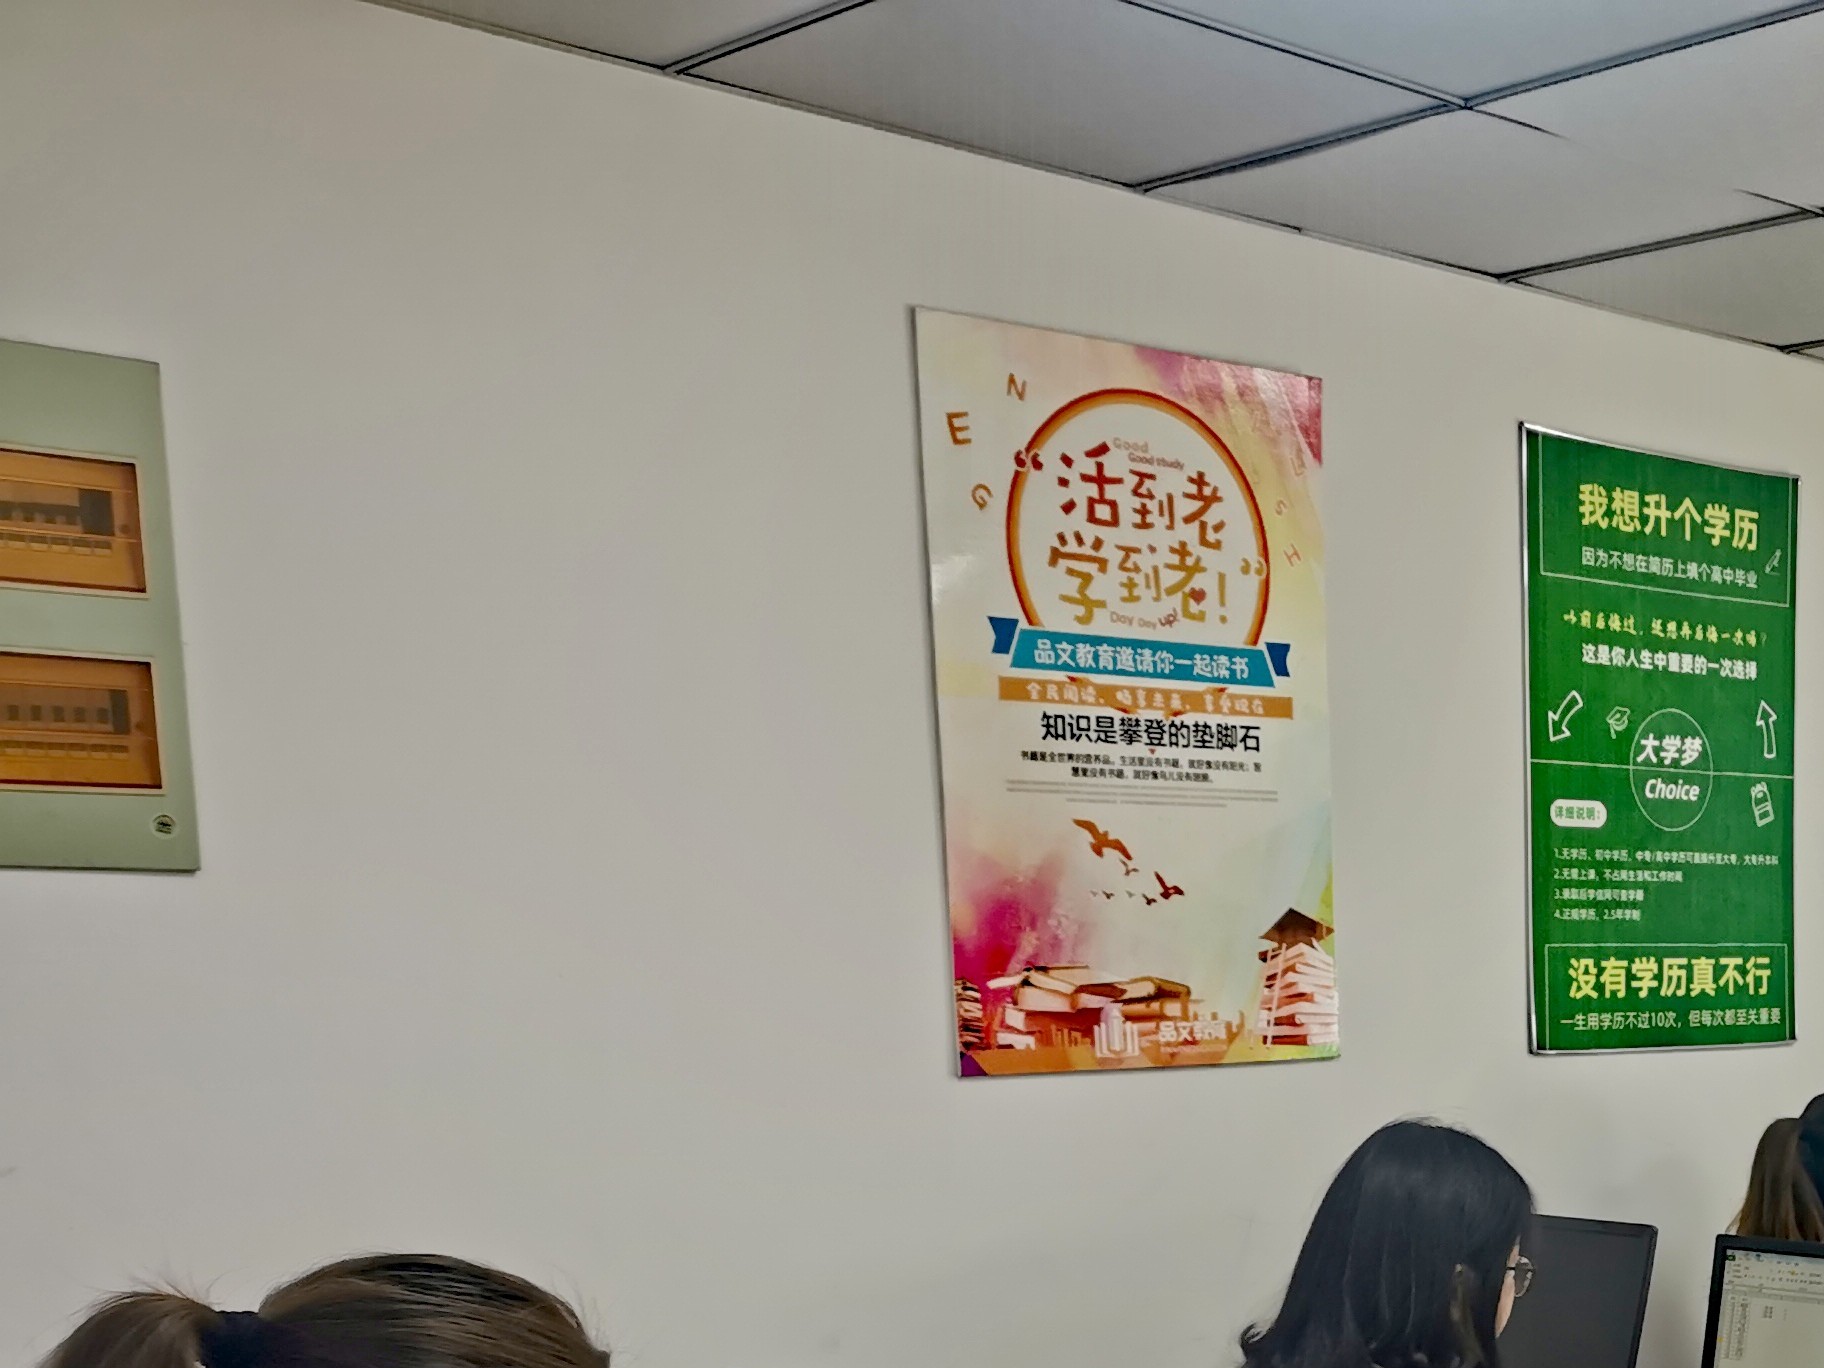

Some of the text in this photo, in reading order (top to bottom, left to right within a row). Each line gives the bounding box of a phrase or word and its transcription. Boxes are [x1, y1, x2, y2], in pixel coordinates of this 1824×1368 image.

[1579, 483, 1760, 551] 我想升个学历
[1581, 546, 1758, 589] 因为不想在简历上填个高中毕业
[1033, 639, 1250, 681] 品文教育邀请你一起读书
[1581, 642, 1757, 681] 这是你人生中重要的一次选择
[1040, 711, 1261, 753] 知识是攀登的垫脚石
[1636, 734, 1702, 767] 大学梦
[1645, 778, 1700, 801] Choice
[1568, 956, 1772, 1000] 没有学历真不行
[1559, 1007, 1781, 1031] 一生用学历不过10次，但每次都至关重要
